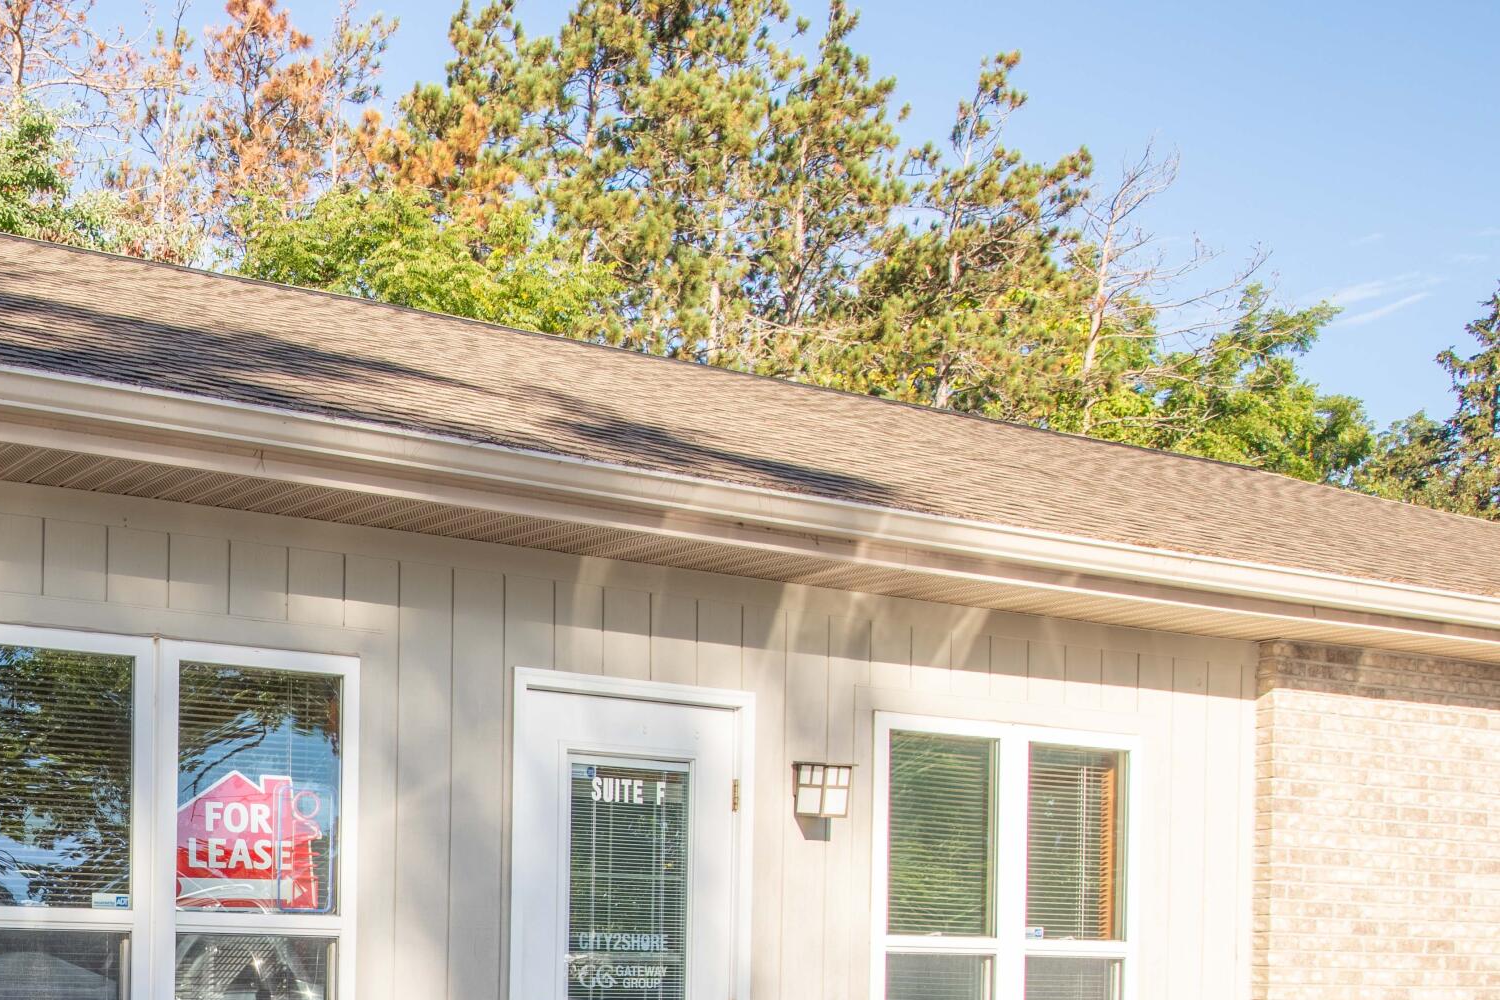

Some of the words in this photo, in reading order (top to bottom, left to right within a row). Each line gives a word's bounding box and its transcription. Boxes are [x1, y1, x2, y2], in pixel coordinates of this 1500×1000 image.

[591, 776, 643, 804] SUITE
[656, 781, 666, 805] F
[205, 801, 273, 834] FOR
[188, 838, 293, 871] LEASE
[615, 966, 668, 978] GATEWAY
[622, 978, 661, 989] GROUP
